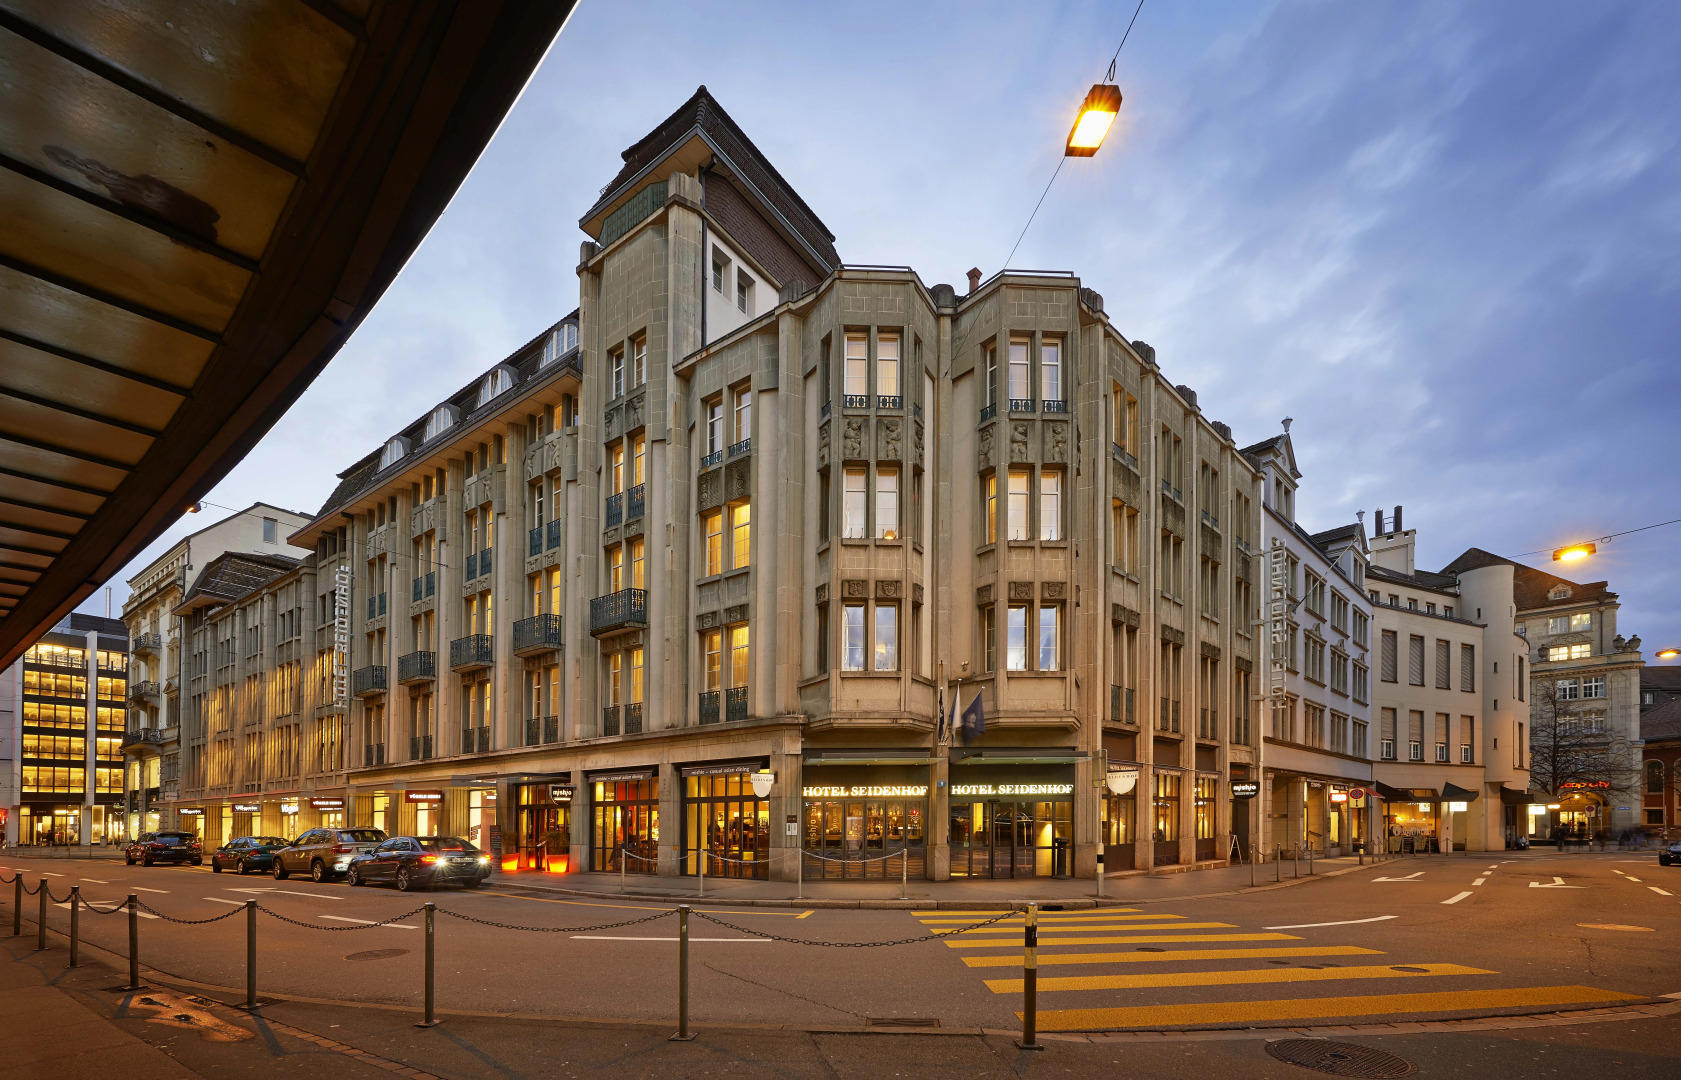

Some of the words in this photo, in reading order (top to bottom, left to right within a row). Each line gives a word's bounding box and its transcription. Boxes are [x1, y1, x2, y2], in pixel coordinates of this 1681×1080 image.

[803, 786, 849, 796] HOTEL
[850, 785, 928, 796] SEIDENHOF
[951, 785, 996, 795] HOTEL
[998, 784, 1074, 794] SEIDENHOF
